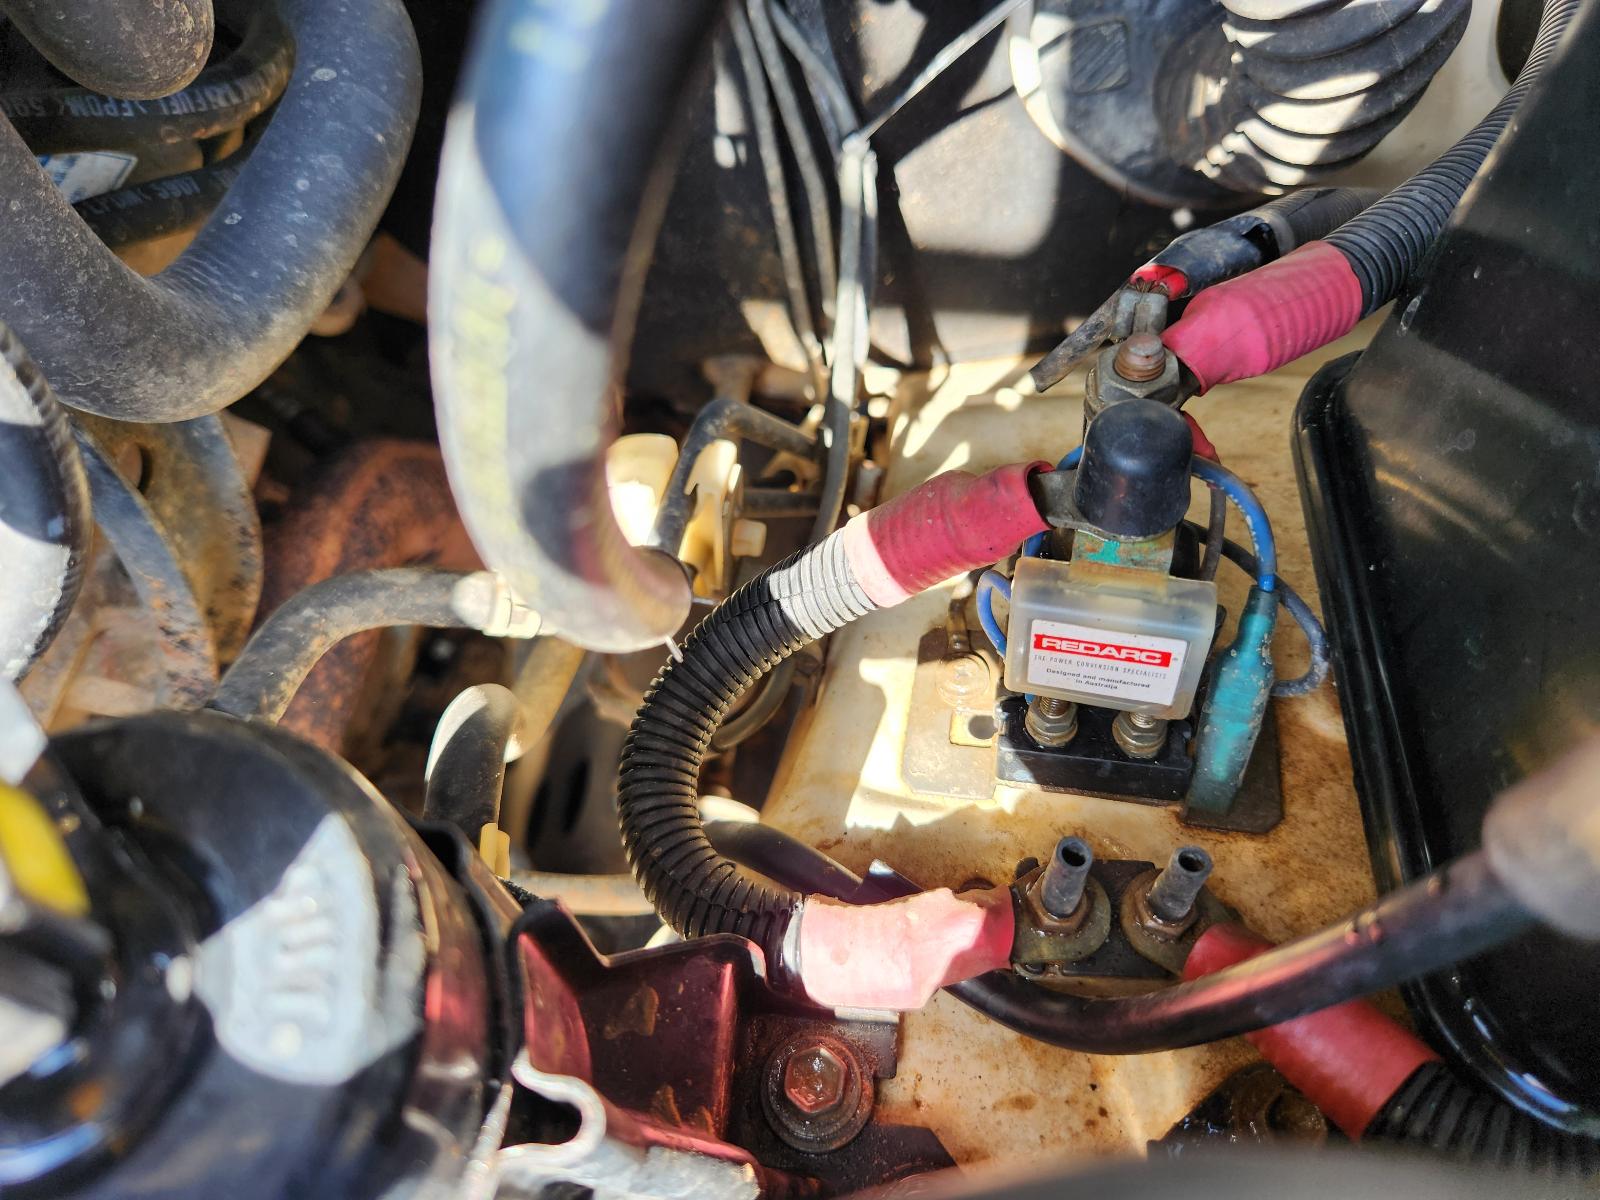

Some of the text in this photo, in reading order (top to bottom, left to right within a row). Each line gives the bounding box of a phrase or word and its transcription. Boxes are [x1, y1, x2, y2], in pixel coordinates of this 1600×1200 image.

[1041, 637, 1162, 664] REDARC
[1034, 654, 1167, 680] THE POWER CONVERSION SPECIALISTS
[1046, 668, 1151, 689] Designed and manufactured
[1084, 679, 1118, 690] Australia
